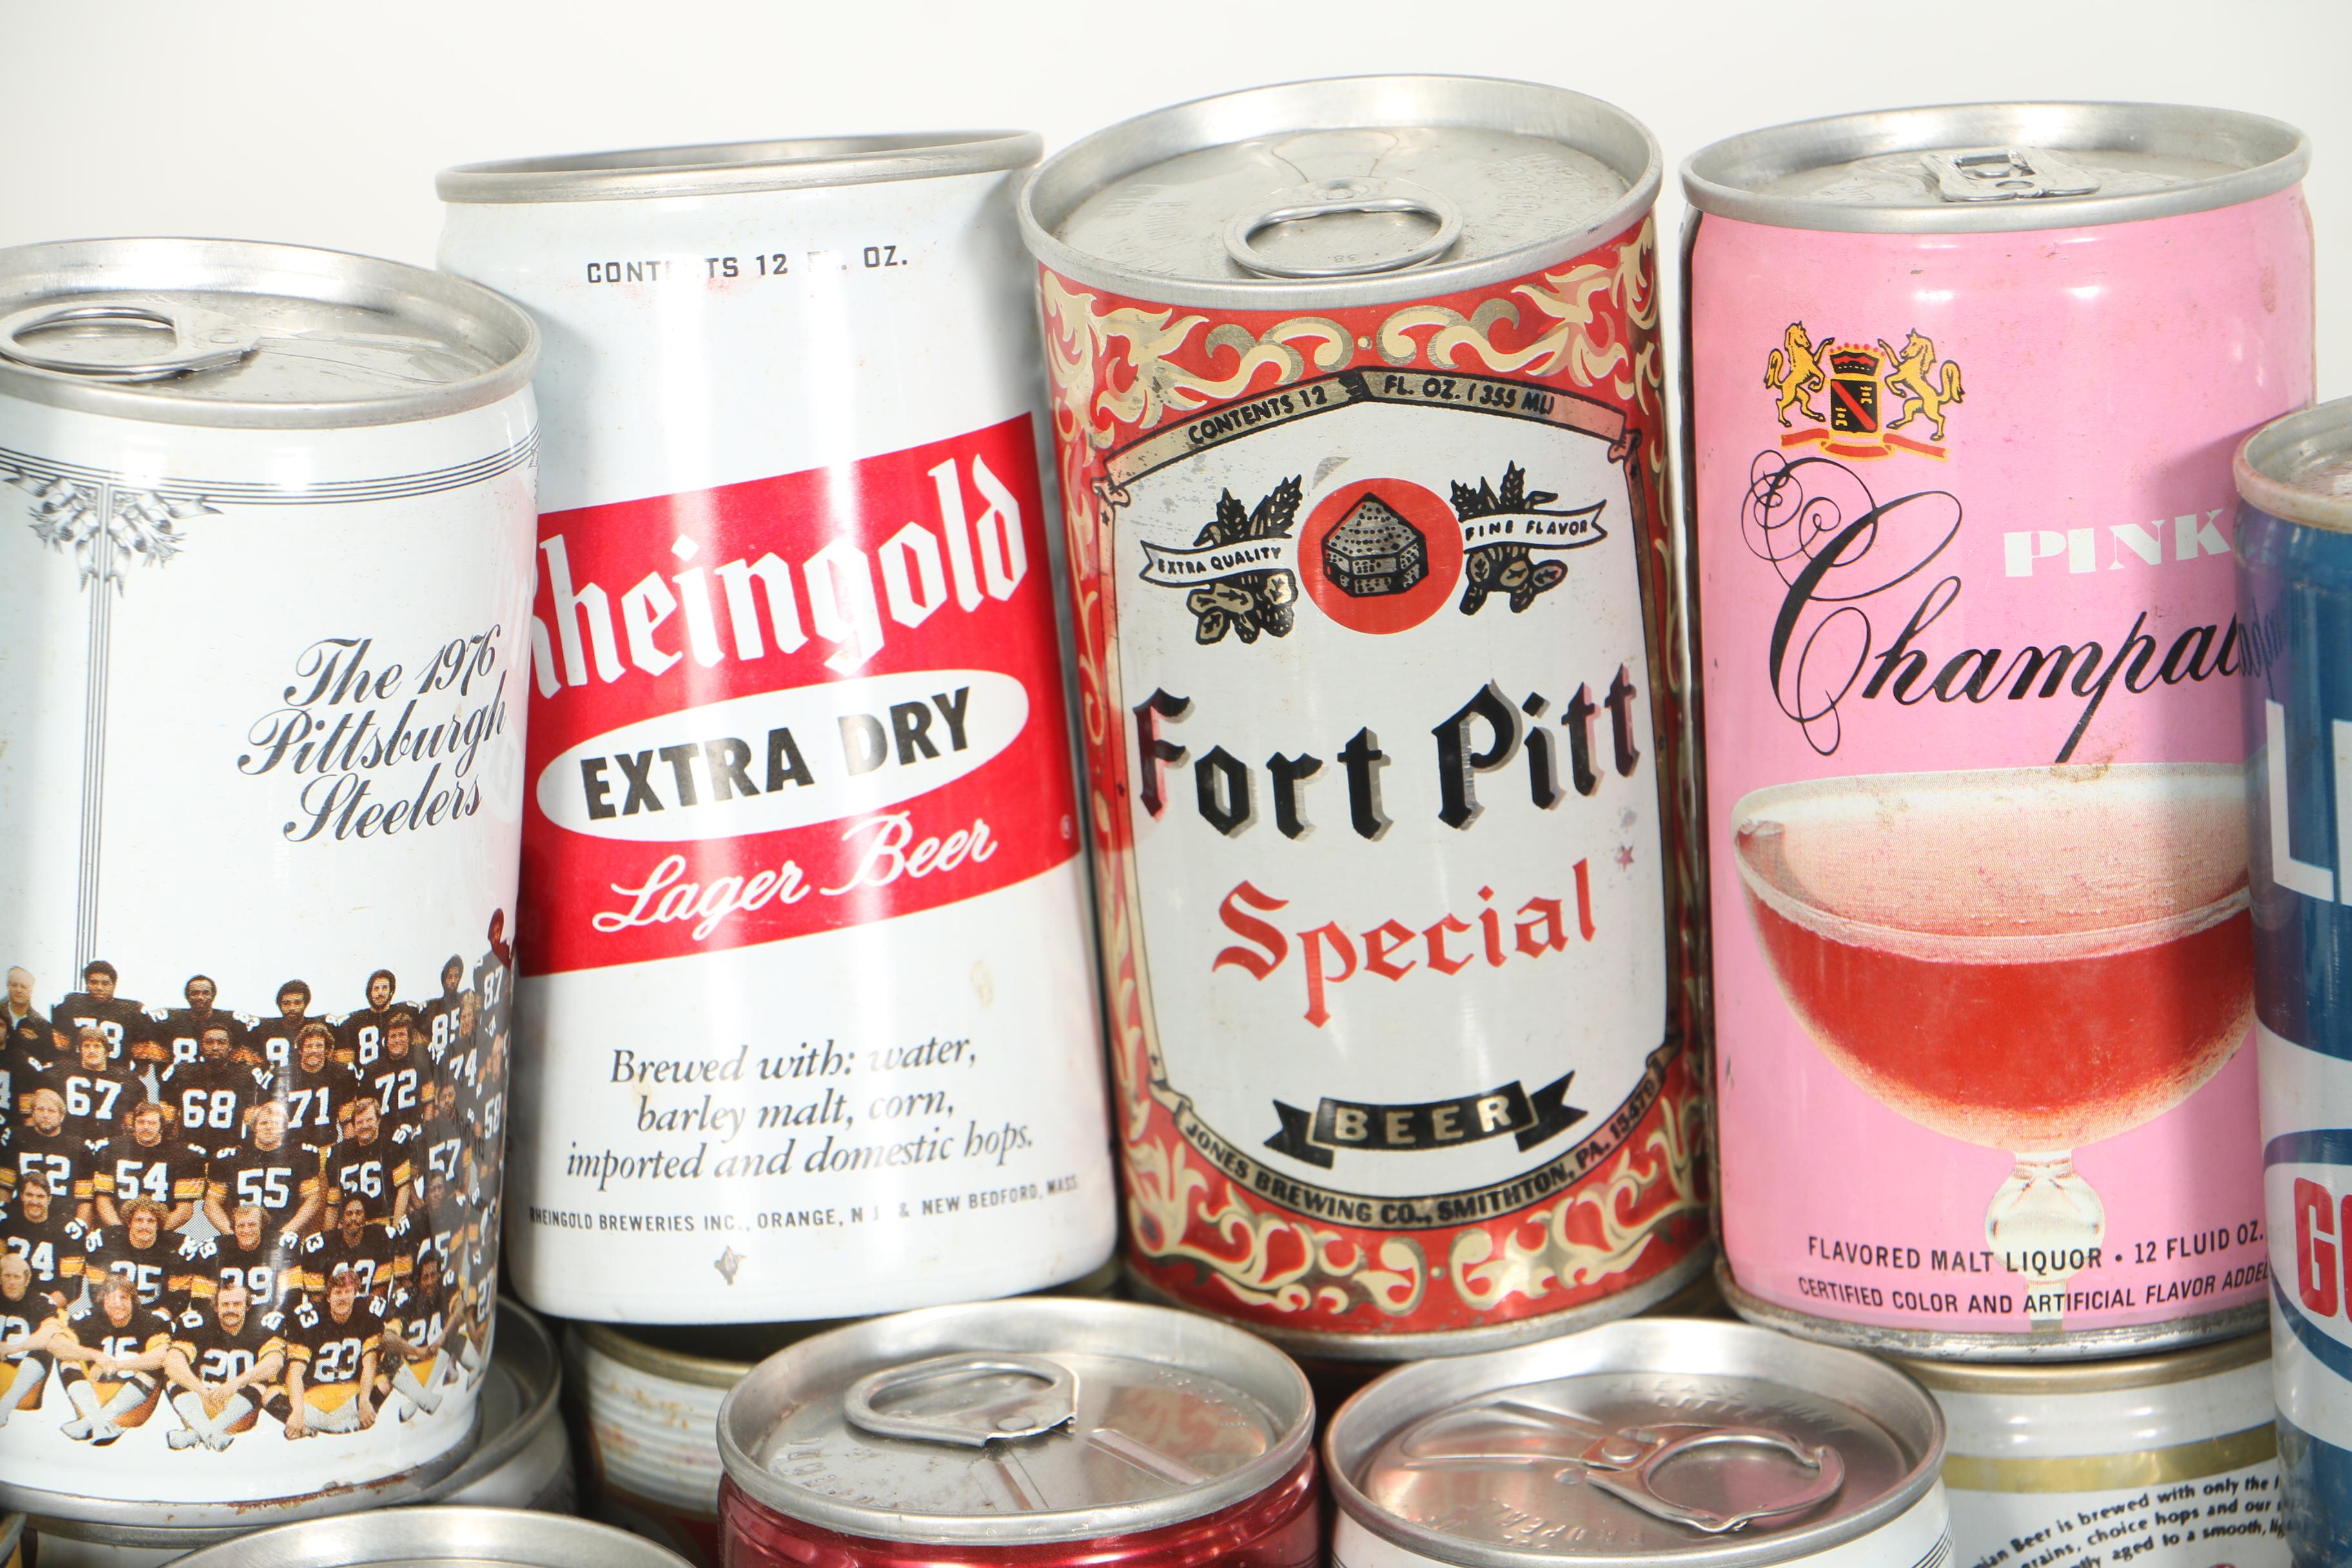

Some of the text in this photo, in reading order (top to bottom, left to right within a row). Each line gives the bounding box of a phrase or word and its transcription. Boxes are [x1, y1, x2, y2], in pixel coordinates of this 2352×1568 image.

[587, 256, 739, 284] CONTTS
[755, 253, 789, 277] 12
[863, 244, 908, 268] OZ.
[1188, 394, 1295, 445] CONTENTS
[1298, 385, 1328, 408] 12
[1384, 375, 1415, 396] FL.
[1422, 377, 1461, 400] OZ.
[1465, 518, 1588, 542] FINE FLAVOR
[2003, 508, 2232, 578] PINK
[1158, 546, 1282, 574] EXTRA QUALITY
[283, 623, 502, 707] The 1976
[237, 669, 507, 778] Pittsburgh
[580, 686, 971, 821] EXTRA DRY
[1133, 662, 1641, 842] Fort Pitt
[282, 761, 482, 843] Steelers
[592, 810, 998, 943] Lager Beer
[1211, 857, 1597, 1028] Special
[484, 965, 504, 1011] 87
[449, 1047, 478, 1088] 74
[609, 1036, 977, 1084] Brewed with: water,
[66, 1075, 123, 1121] 67
[182, 1088, 237, 1129] 68
[288, 1086, 331, 1129] 71
[375, 1067, 418, 1116] 72
[484, 1092, 502, 1140] 58
[637, 1088, 955, 1144] barley malt, corn,
[1333, 1094, 1513, 1145] BEER
[116, 1159, 169, 1202] 54
[340, 1160, 382, 1199] 56
[429, 1138, 462, 1182] 57
[566, 1120, 1034, 1193] imported and domestic hops.
[1185, 1122, 1249, 1181] JONES
[1254, 1168, 1371, 1223] BREWING
[1437, 1163, 1575, 1220] SMITHTON,
[1575, 1139, 1611, 1170] PA.
[237, 1166, 292, 1209] 55
[529, 1206, 593, 1230] RHEINGOLD
[598, 1213, 695, 1231] BREWERIES
[757, 1208, 844, 1230] ORANGE,
[921, 1195, 961, 1217] NEW
[968, 1183, 1044, 1210] BEDFORD,
[1808, 1220, 2264, 1275] FLAVORED MALT LIQUOR 12 FLUID OZ.
[1798, 1276, 1883, 1307] CERTIFIED
[1892, 1291, 1958, 1313] COLOR
[1968, 1294, 2012, 1313] AND
[2023, 1288, 2135, 1313] ARTIFICIAL
[2146, 1275, 2216, 1304] FLAVOR
[2010, 1527, 2052, 1554] Beer
[2056, 1519, 2073, 1534] is
[2077, 1493, 2150, 1525] brewed
[2157, 1484, 2195, 1504] with
[2202, 1477, 2239, 1496] only
[2245, 1475, 2269, 1491] the
[2086, 1518, 2148, 1545] choice
[2154, 1506, 2200, 1526] hops
[2206, 1498, 2239, 1516] and
[2244, 1500, 2271, 1513] our
[2112, 1536, 2155, 1562] aged
[2162, 1533, 2180, 1547] to
[2186, 1530, 2196, 1542] a
[2202, 1520, 2267, 1540] smooth,
